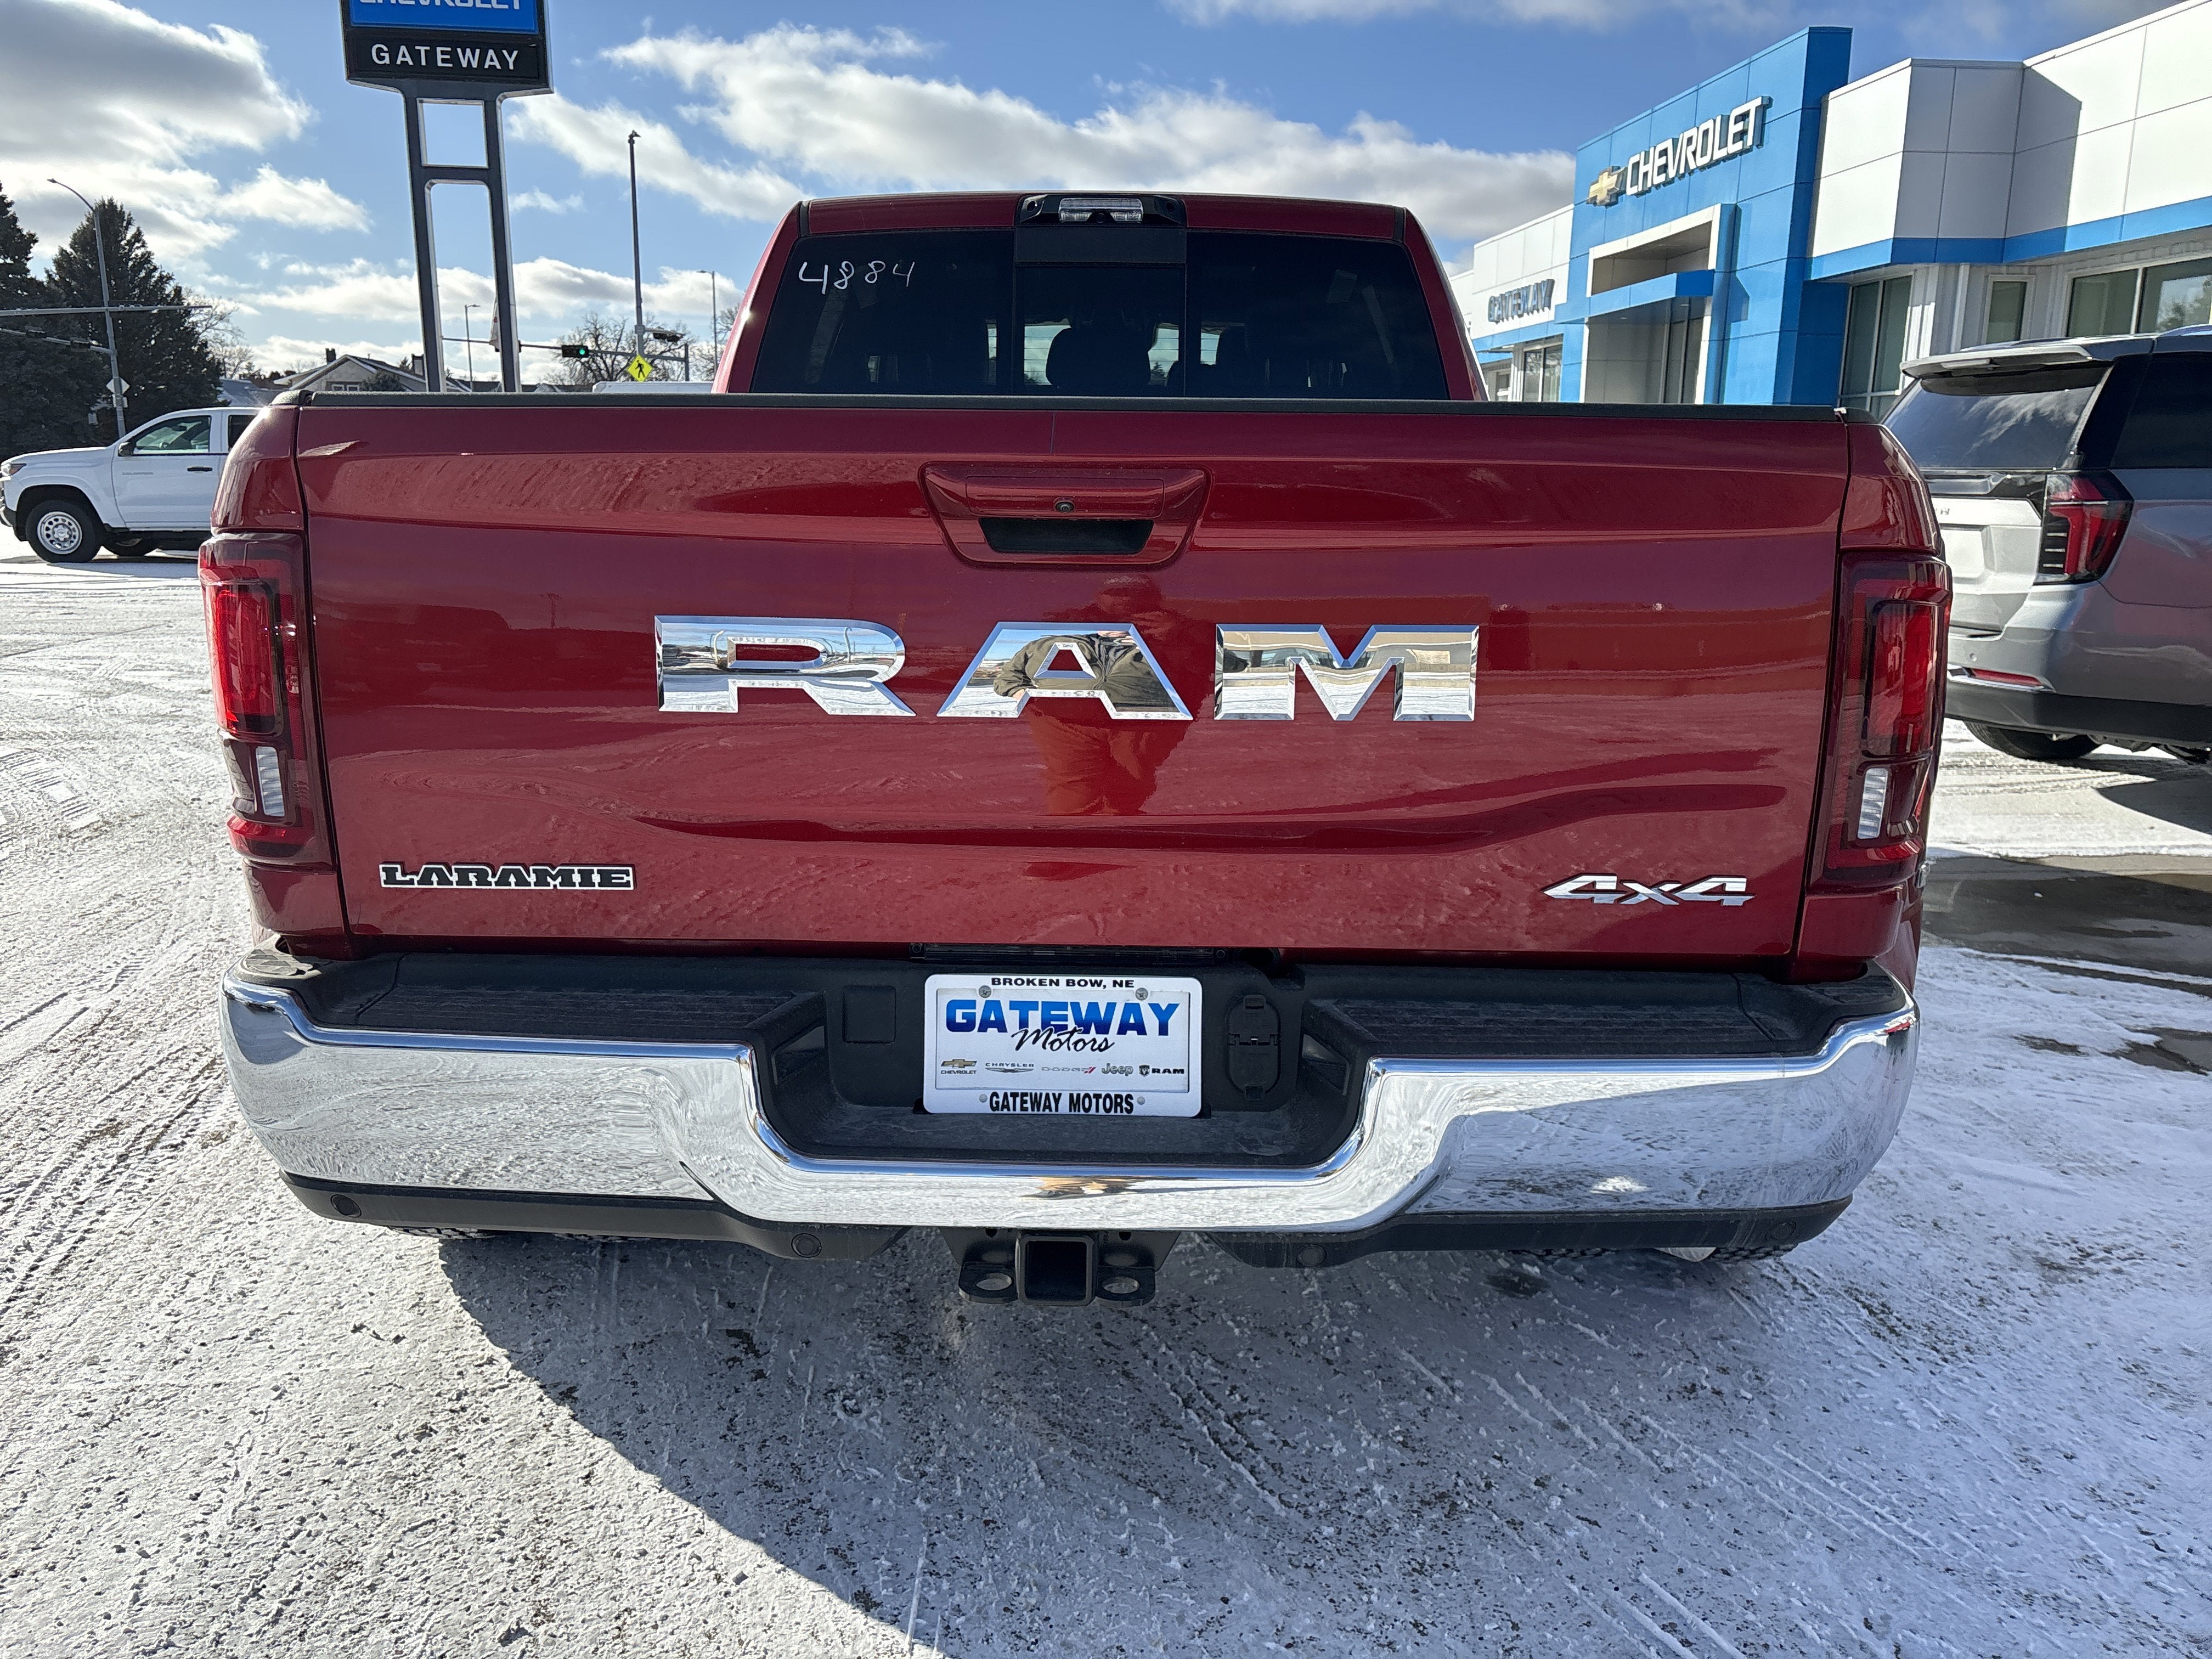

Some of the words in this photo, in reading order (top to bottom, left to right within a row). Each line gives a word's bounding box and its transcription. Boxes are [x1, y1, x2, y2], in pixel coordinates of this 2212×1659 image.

[371, 43, 518, 70] GATEWAY
[1626, 95, 1768, 196] CHEVROLET
[798, 260, 915, 295] 4884
[1487, 278, 1555, 324] GATEWAY
[654, 616, 1480, 722] RAM
[379, 863, 635, 890] LARAMIE
[1541, 873, 1756, 906] 4x4
[991, 977, 1060, 987] BROKEN
[1065, 978, 1107, 990] BOW,
[1112, 979, 1135, 988] NE
[945, 999, 1180, 1036] GATEWAY
[1011, 1026, 1115, 1052] Motors
[1101, 1063, 1134, 1076] Jeep
[989, 1091, 1063, 1113] GATEWAY
[1069, 1092, 1134, 1114] MOTORS
